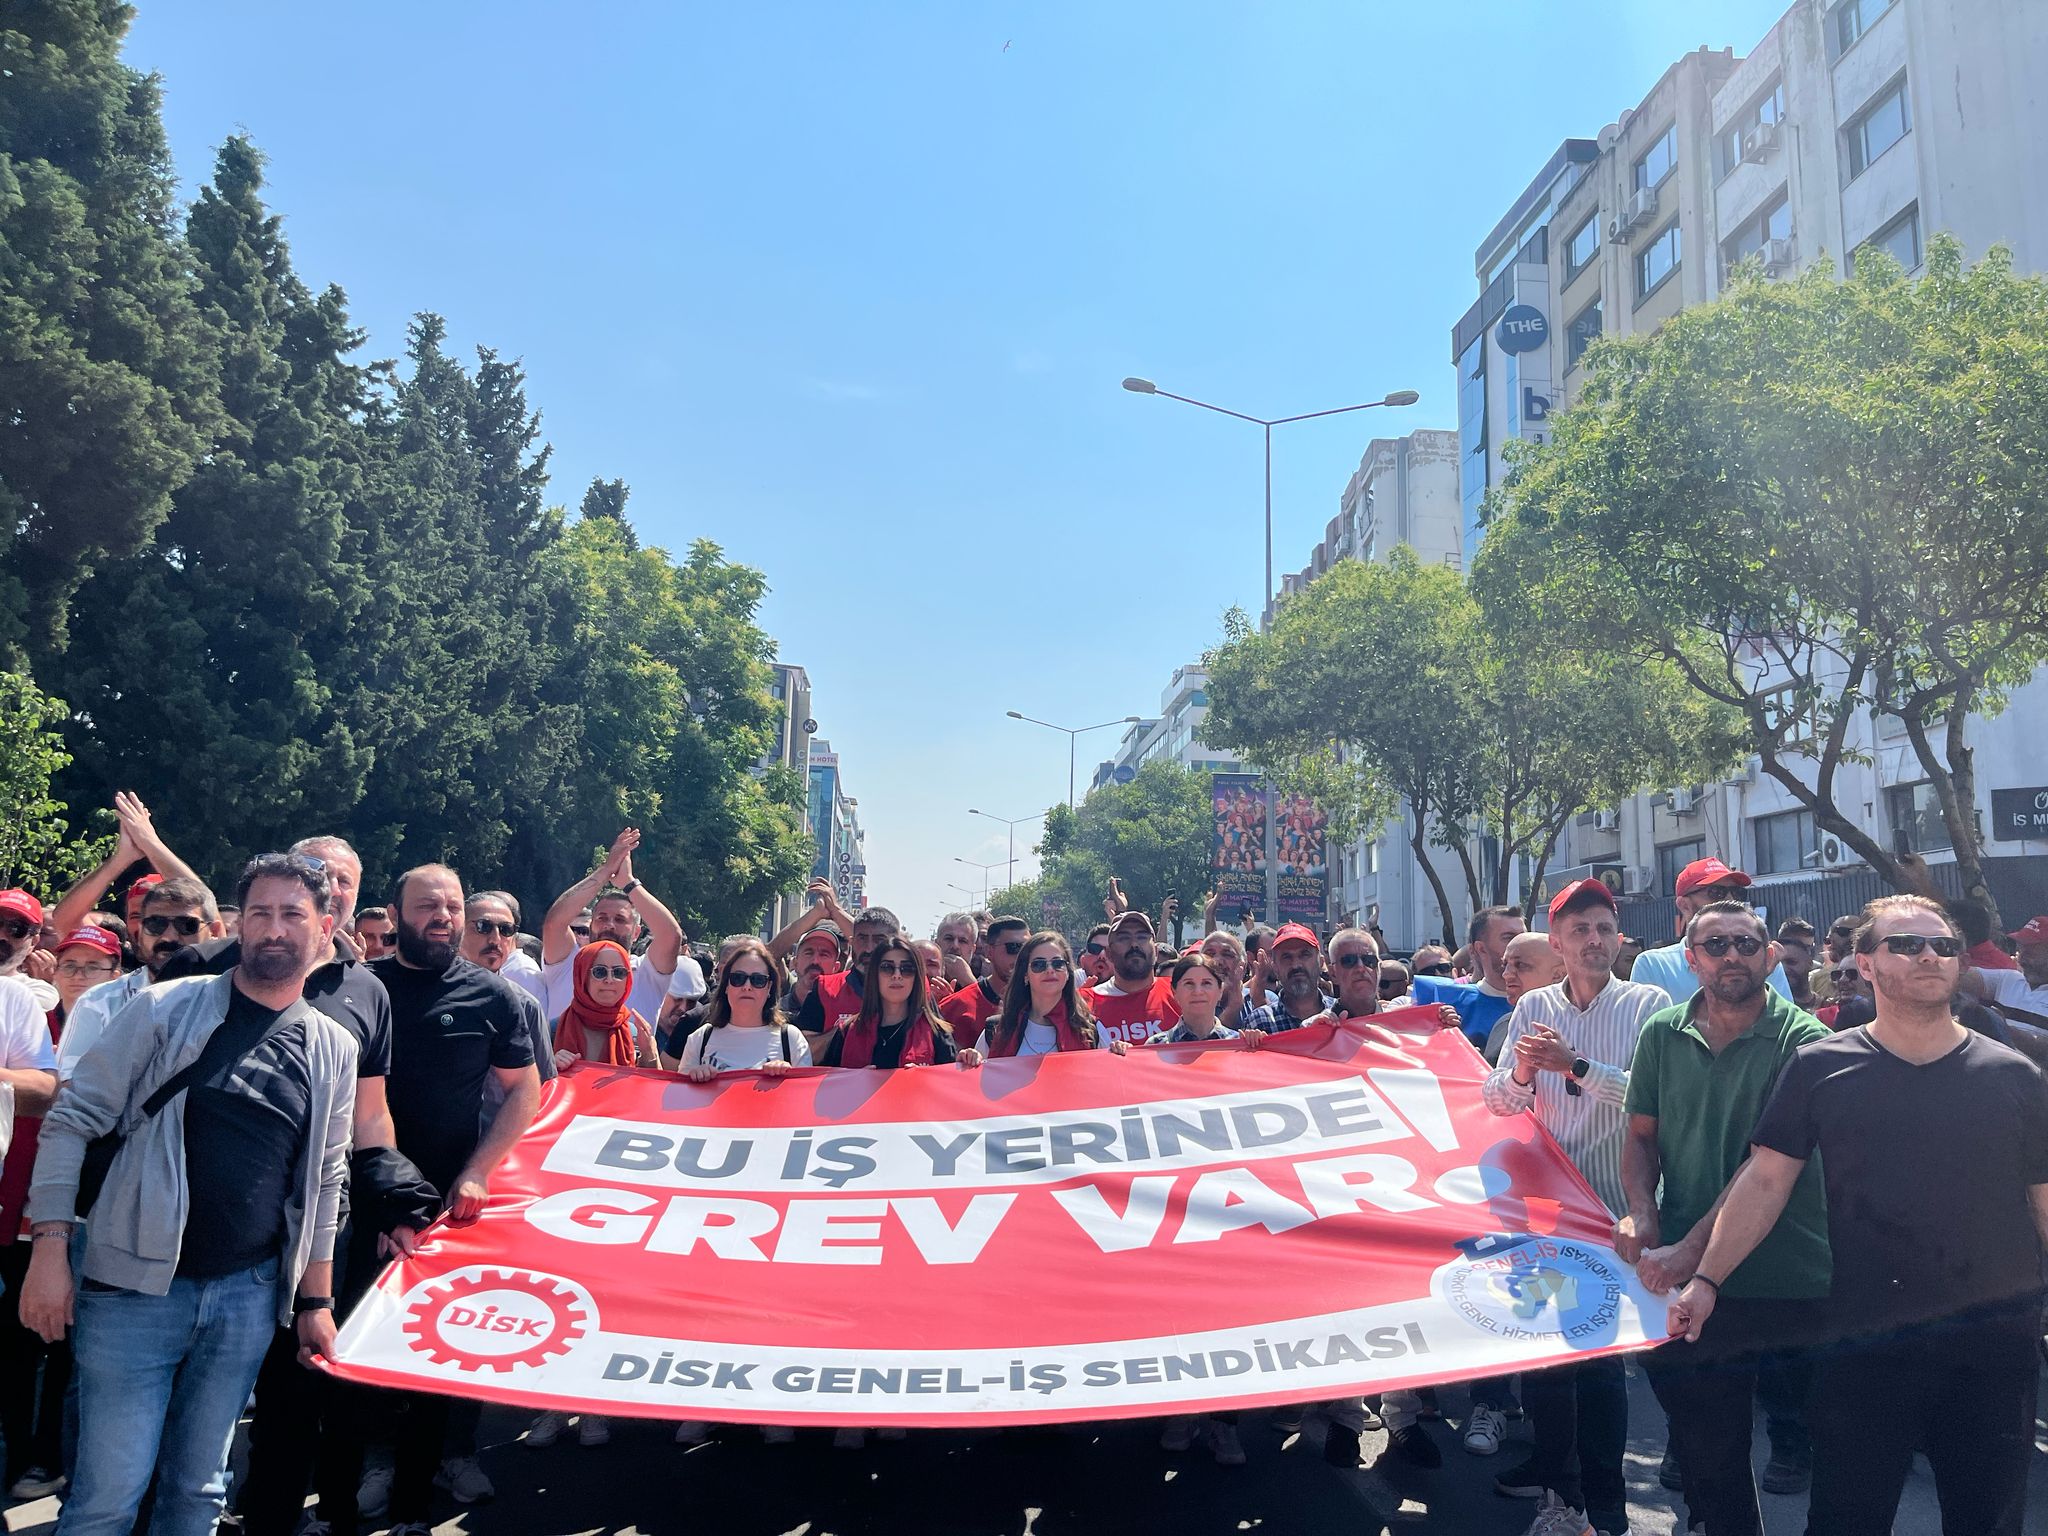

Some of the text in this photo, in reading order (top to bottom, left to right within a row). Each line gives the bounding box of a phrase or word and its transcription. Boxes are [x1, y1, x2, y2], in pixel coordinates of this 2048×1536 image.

[1506, 318, 1544, 334] THE
[2032, 813, 2048, 826] M
[1106, 1019, 1163, 1042] DİSK
[594, 1087, 1384, 1189] BU İŞ YERİNDE
[524, 1187, 1019, 1266] GREV
[1471, 1240, 1560, 1272] GENEL-İŞ
[444, 1306, 548, 1338] DİSK
[1459, 1299, 1498, 1333] GENEL
[601, 1320, 1431, 1396] DİSK GENEL-İŞ SENDİKASI
